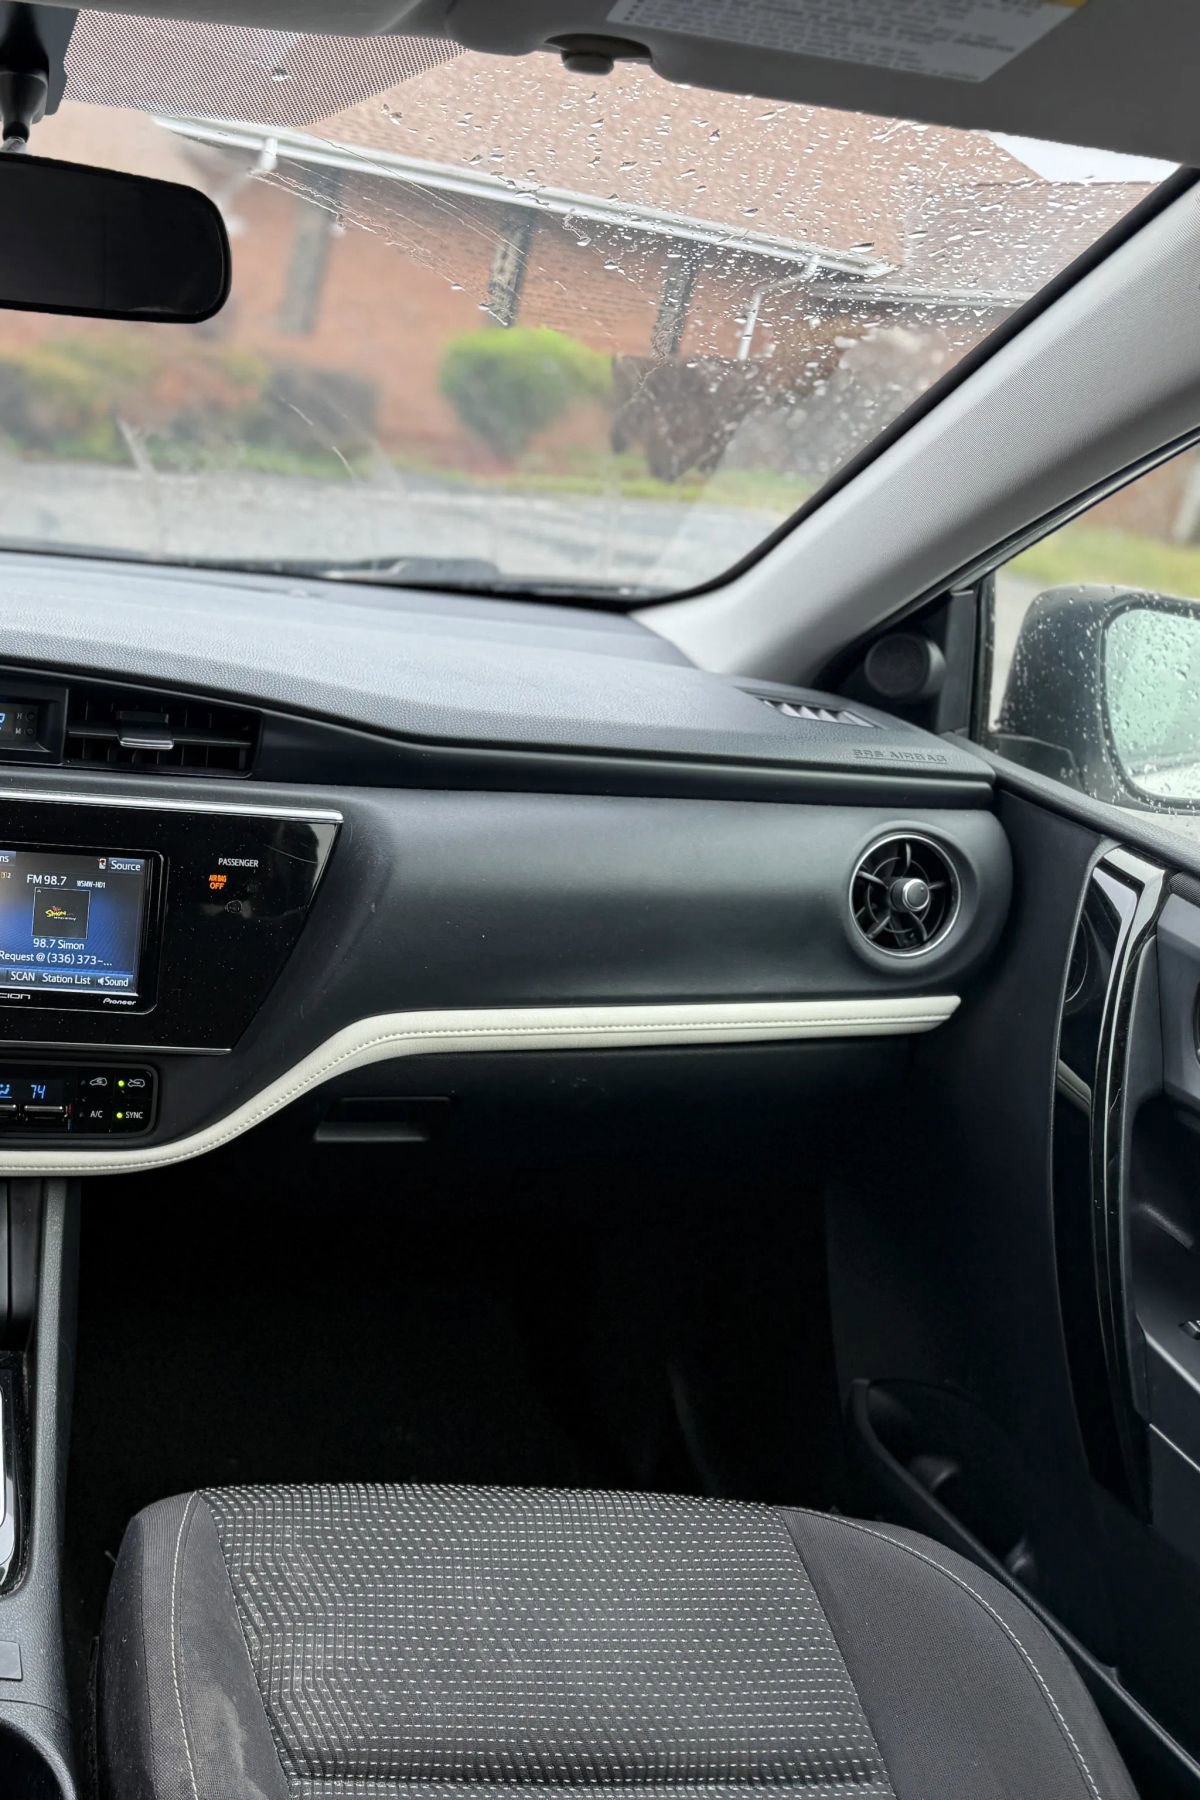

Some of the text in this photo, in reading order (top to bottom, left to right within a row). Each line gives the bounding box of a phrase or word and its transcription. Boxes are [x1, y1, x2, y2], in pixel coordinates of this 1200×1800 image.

[111, 860, 141, 871] Source
[218, 858, 259, 868] PASSENGER
[26, 874, 67, 886] FM 98.7
[33, 938, 84, 950] 98.7 Simon
[36, 953, 46, 962] @
[47, 952, 75, 966] (336)
[10, 971, 35, 982] SCAN
[42, 973, 91, 985] Station List
[104, 976, 129, 987] Sound
[103, 997, 137, 1006] Pioneer
[31, 1084, 46, 1099] 74
[90, 1110, 103, 1118] A/C
[125, 1111, 144, 1119] SYNC
